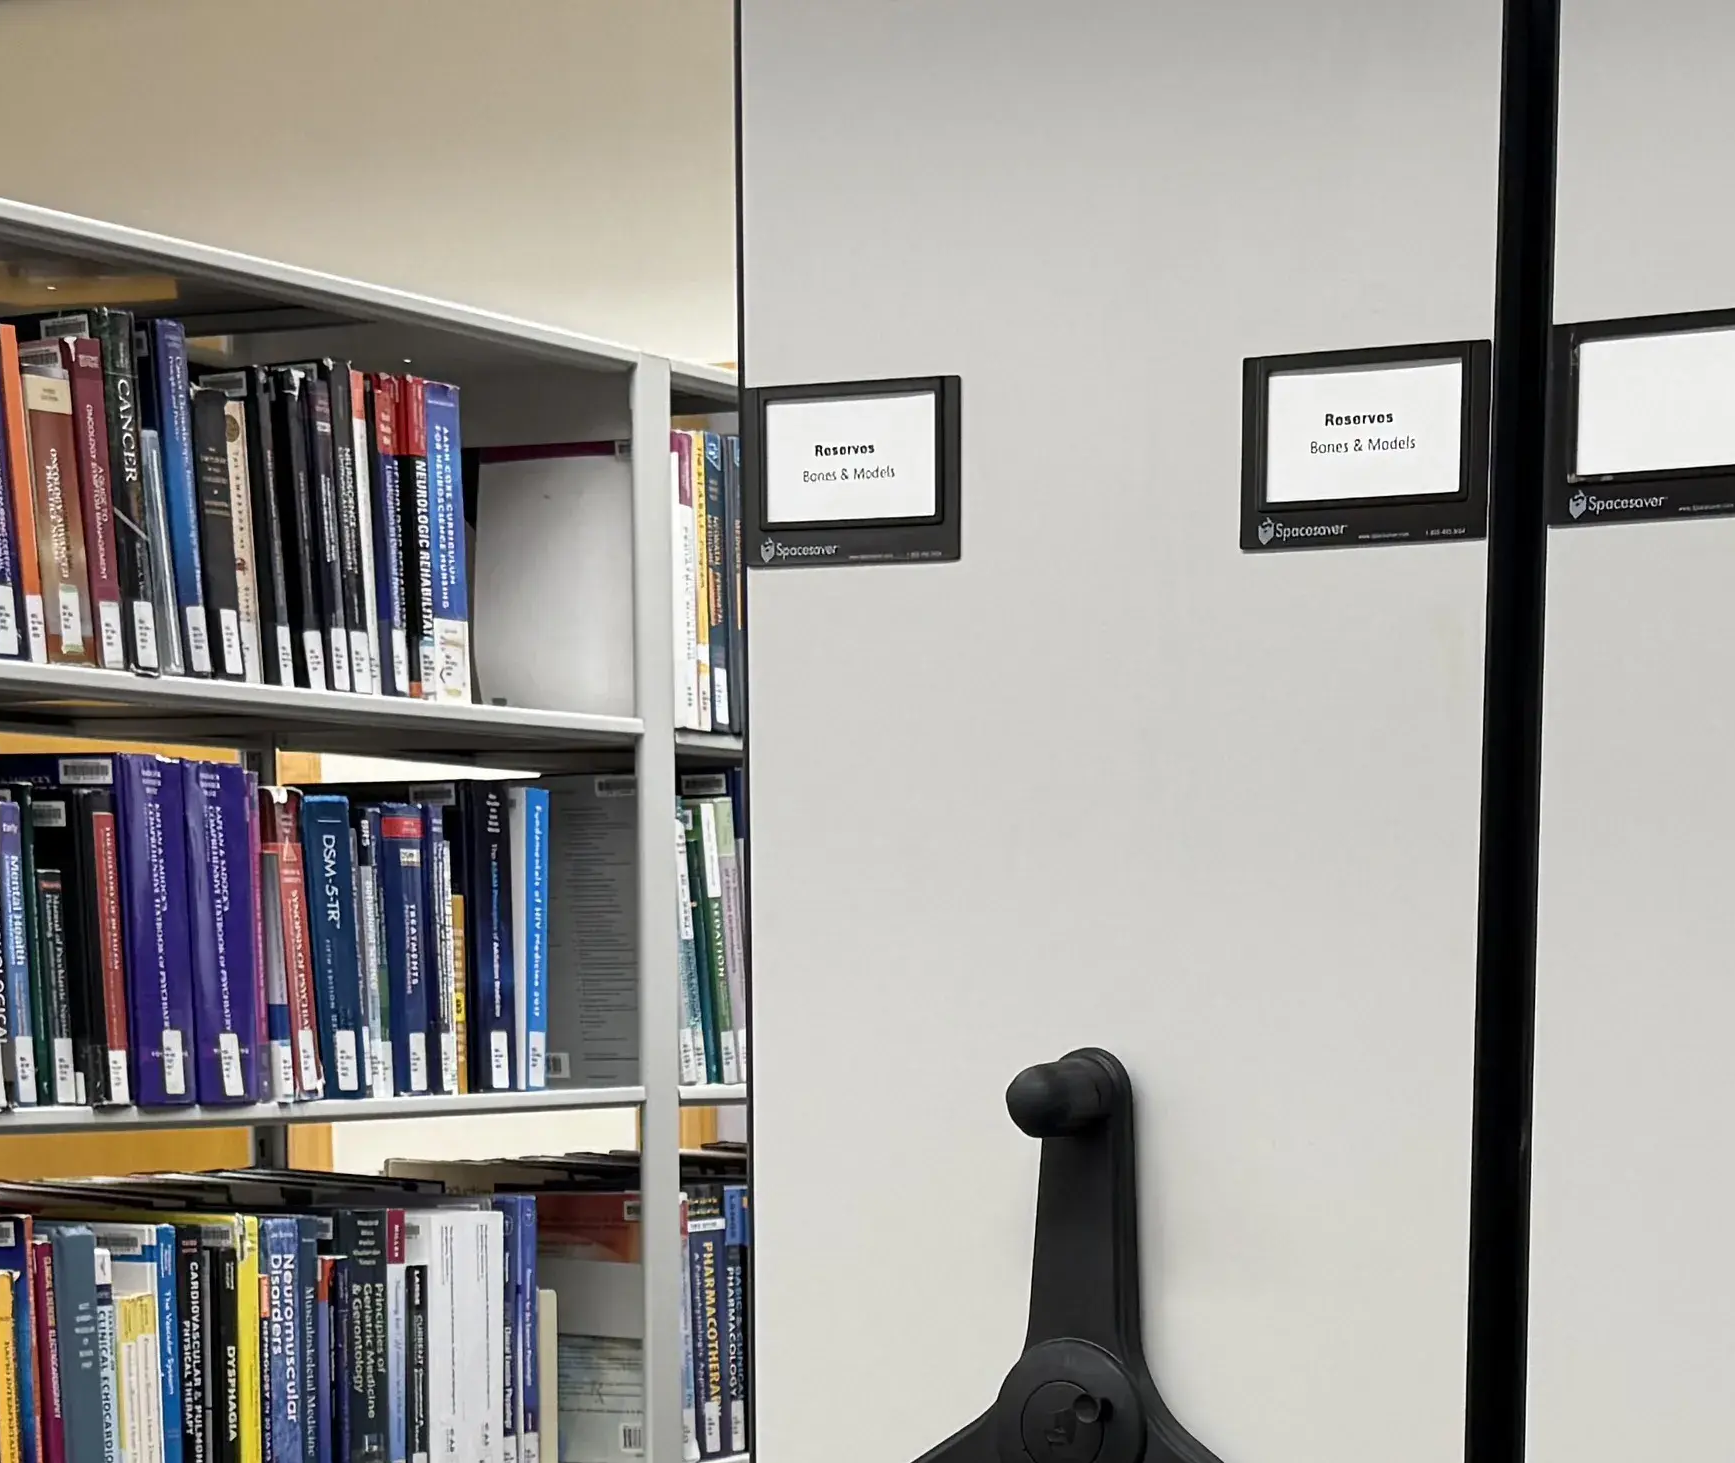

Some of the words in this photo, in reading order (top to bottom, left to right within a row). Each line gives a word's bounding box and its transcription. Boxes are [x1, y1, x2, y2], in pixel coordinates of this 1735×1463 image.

[116, 378, 137, 482] CANCER
[814, 444, 875, 457] Reserves
[1310, 440, 1349, 454] Bones
[1353, 438, 1363, 452] &
[1367, 435, 1416, 451] Models
[1324, 412, 1394, 427] Reserves
[415, 460, 431, 547] NEUROLOGIC
[803, 470, 837, 483] Bones
[840, 468, 849, 480] &
[853, 465, 895, 480] Models
[1588, 496, 1665, 515] Spacesaver
[776, 542, 839, 560] Spacesaver
[1275, 523, 1347, 542] Spacesaver
[712, 902, 725, 978] SEDATION
[188, 1262, 202, 1387] CARDIOVASCULAR
[270, 1253, 284, 1355] Disorders
[282, 1253, 298, 1423] Neuromuscular
[363, 1284, 375, 1346] Geriatric
[374, 1284, 386, 1352] Principles
[727, 1267, 737, 1397] PHARMACOLOGY
[182, 1320, 193, 1378] PHYSICAL
[304, 1286, 316, 1392] Musculoskeletal
[352, 1302, 365, 1393] Gerontology
[184, 1381, 194, 1435] THERAPY
[226, 1345, 238, 1442] DYSPHAGIA
[366, 1351, 378, 1419] Medicine
[306, 1395, 317, 1456] Medicine
